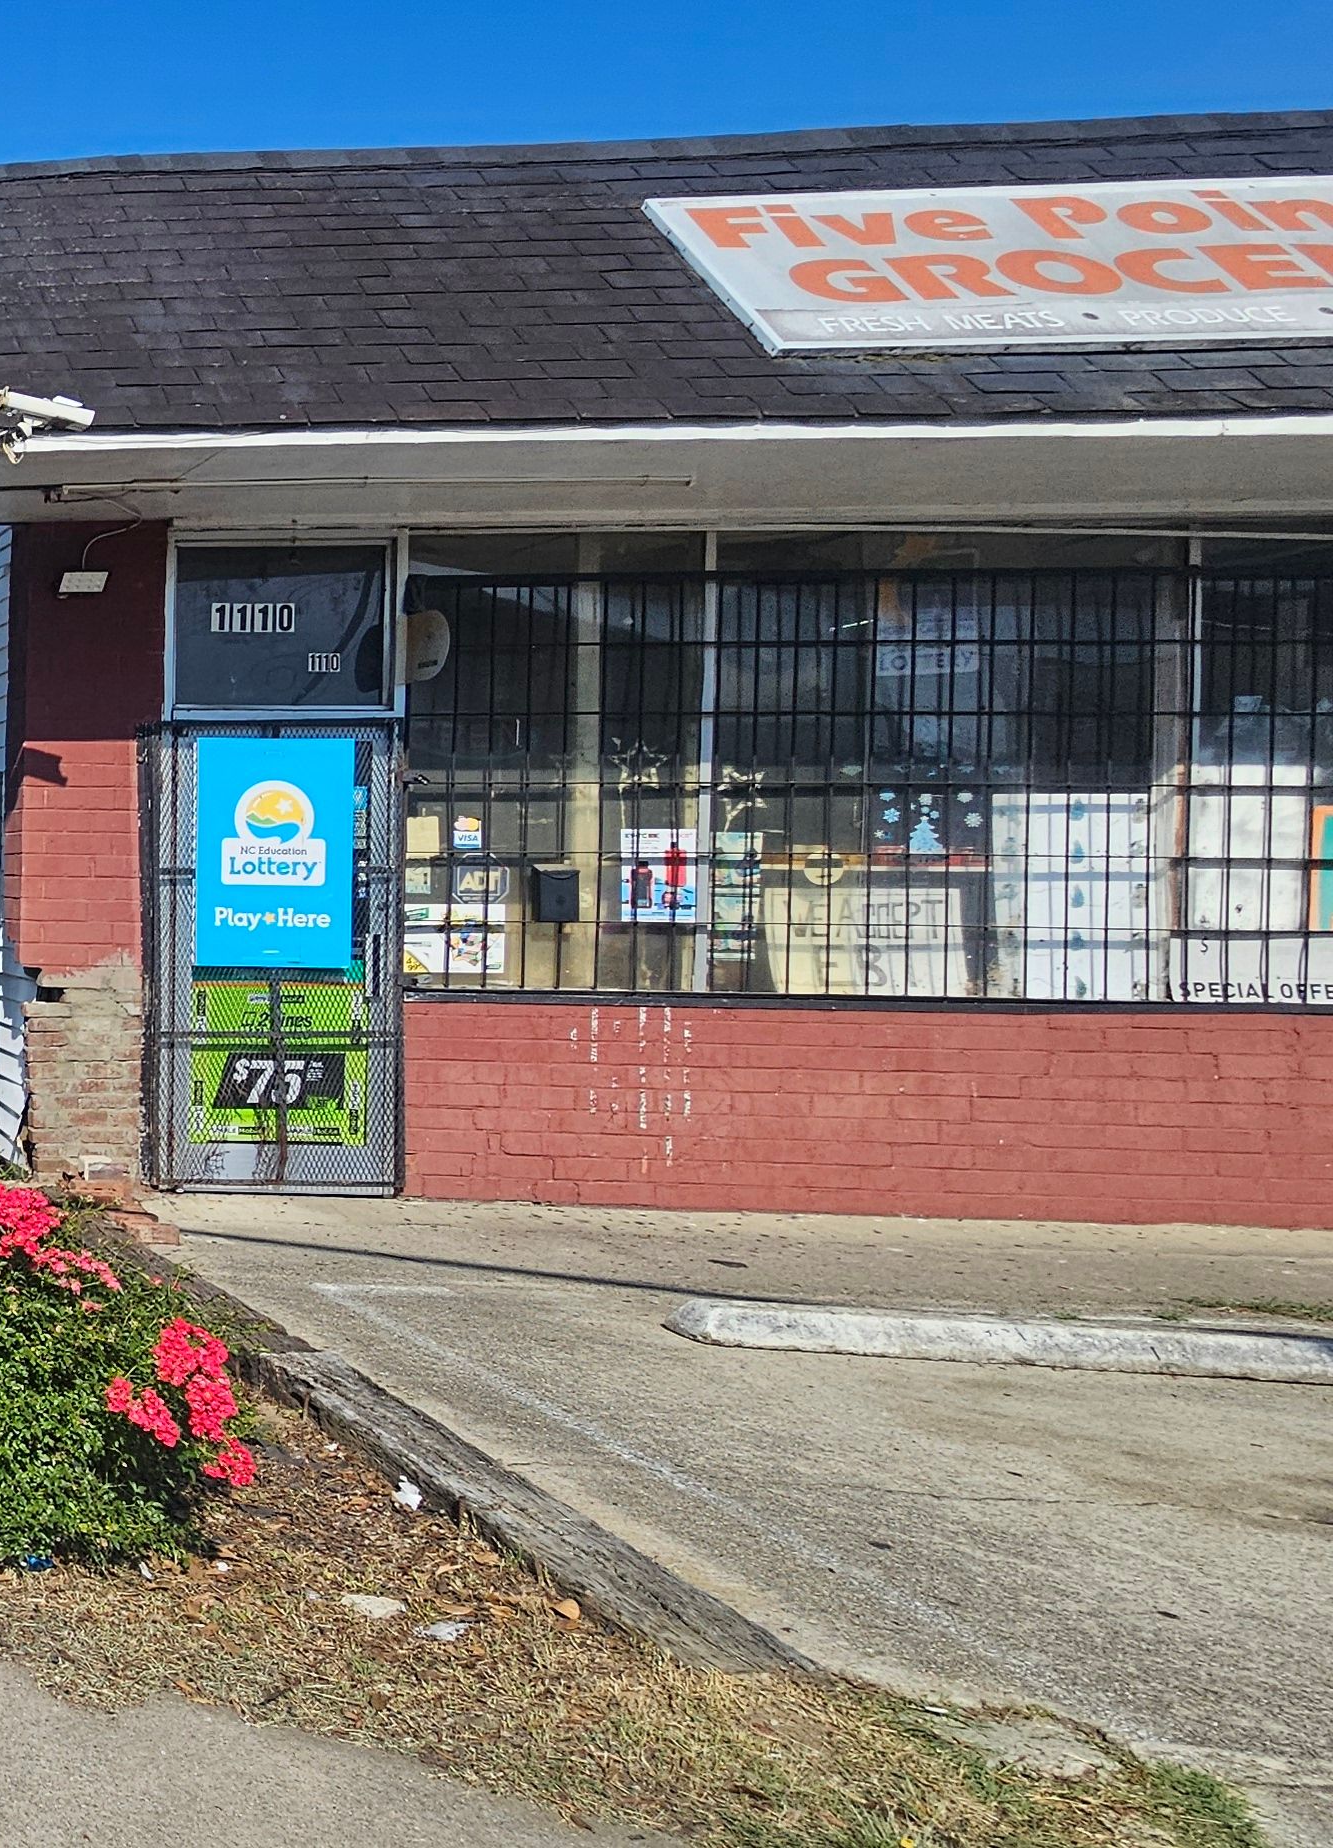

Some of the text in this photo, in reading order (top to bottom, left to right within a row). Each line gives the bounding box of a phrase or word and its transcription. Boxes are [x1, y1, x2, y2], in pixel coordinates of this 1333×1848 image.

[685, 202, 995, 249] Five
[817, 305, 1300, 336] FRESH MEATS PRODUCE
[213, 603, 294, 632] 1110
[309, 653, 340, 672] 1110
[458, 834, 480, 843] VISA
[240, 846, 308, 856] NC Education
[229, 857, 318, 881] Lottery
[459, 871, 502, 892] ADT
[214, 906, 331, 931] Play Here
[784, 897, 943, 939] WE ACCEPT
[1179, 981, 1274, 999] SPECIAL
[232, 1058, 306, 1105] $75
